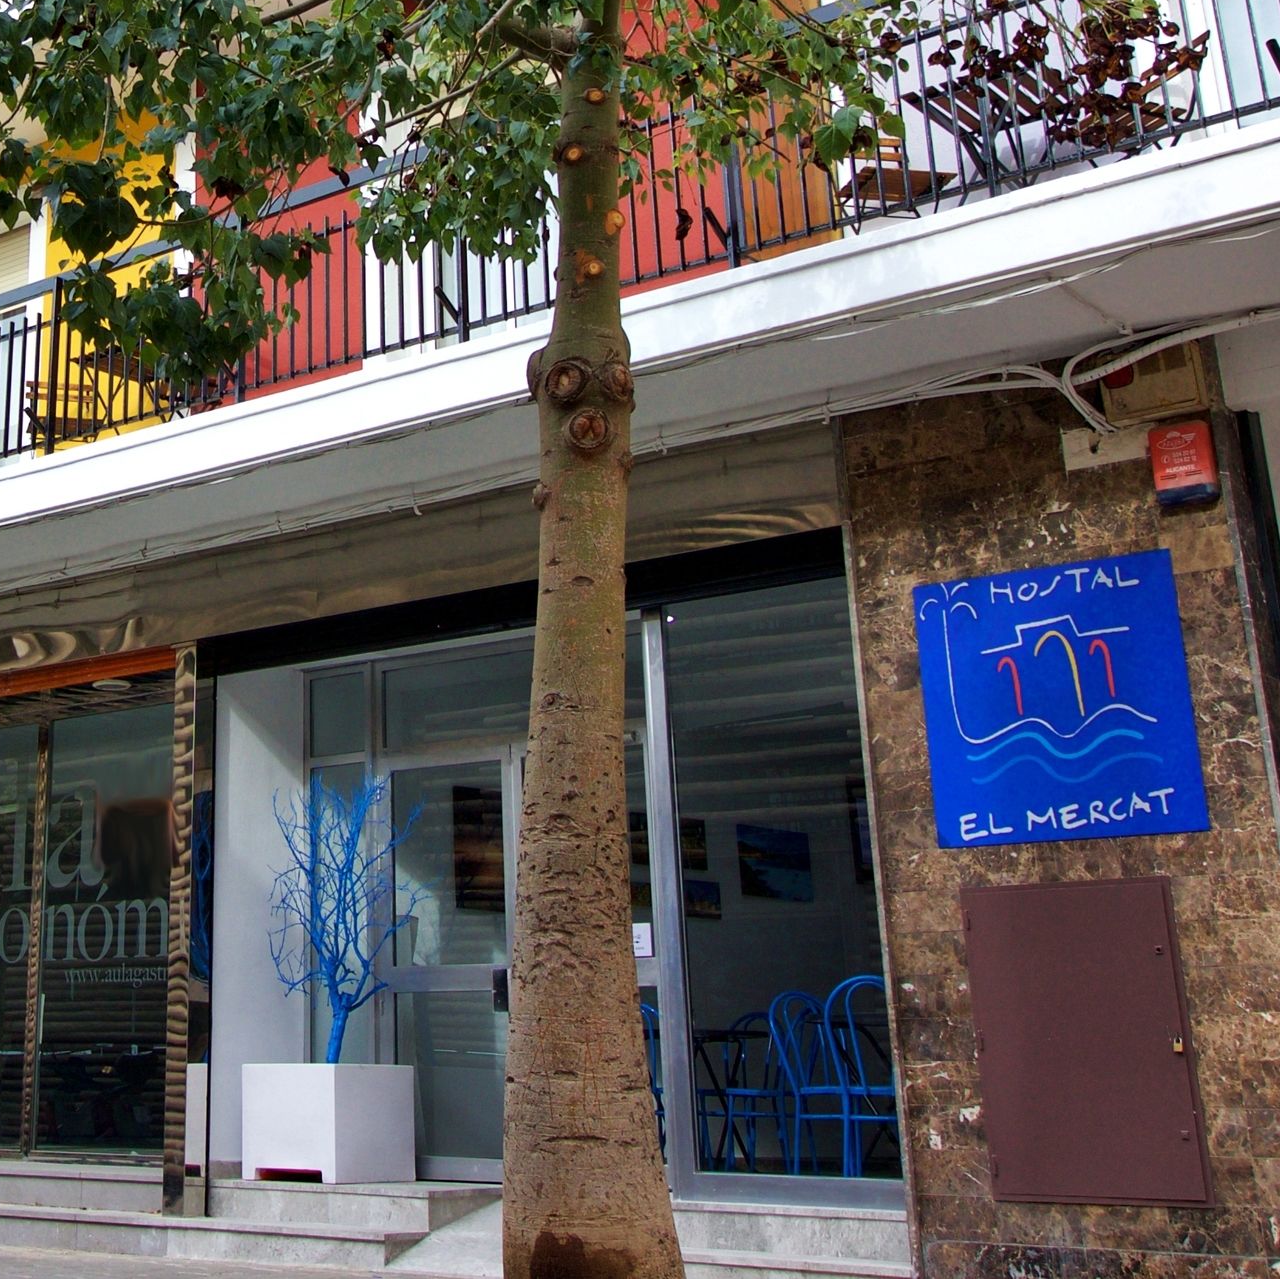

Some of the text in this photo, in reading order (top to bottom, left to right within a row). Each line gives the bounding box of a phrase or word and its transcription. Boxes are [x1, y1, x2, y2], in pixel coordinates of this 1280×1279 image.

[990, 566, 1140, 604] HOSTAL
[960, 787, 1175, 841] EL MERCAT
